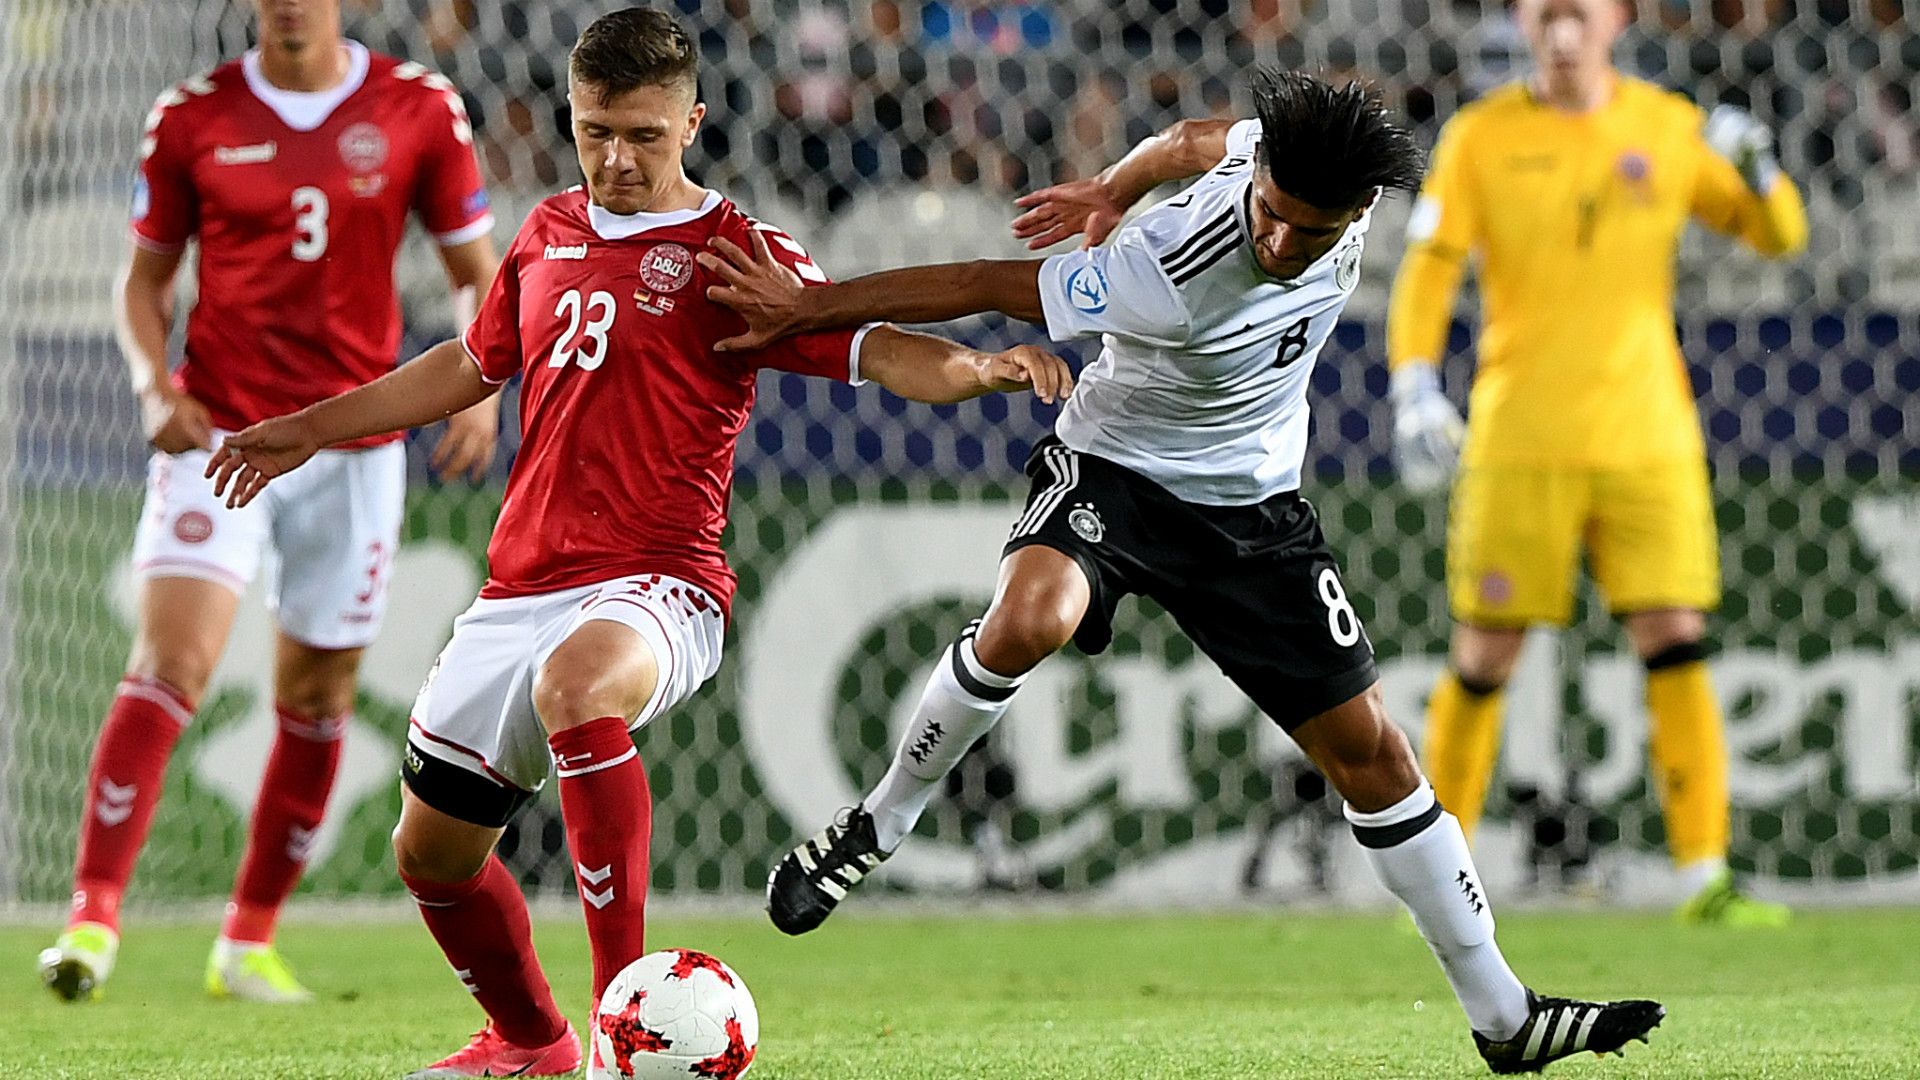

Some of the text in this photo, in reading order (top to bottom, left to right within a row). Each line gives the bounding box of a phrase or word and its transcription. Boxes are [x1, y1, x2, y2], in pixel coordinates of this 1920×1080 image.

[291, 186, 330, 262] 3
[651, 256, 683, 278] DBU
[547, 289, 617, 372] 23
[1272, 316, 1311, 369] 8
[1318, 568, 1360, 647] 8
